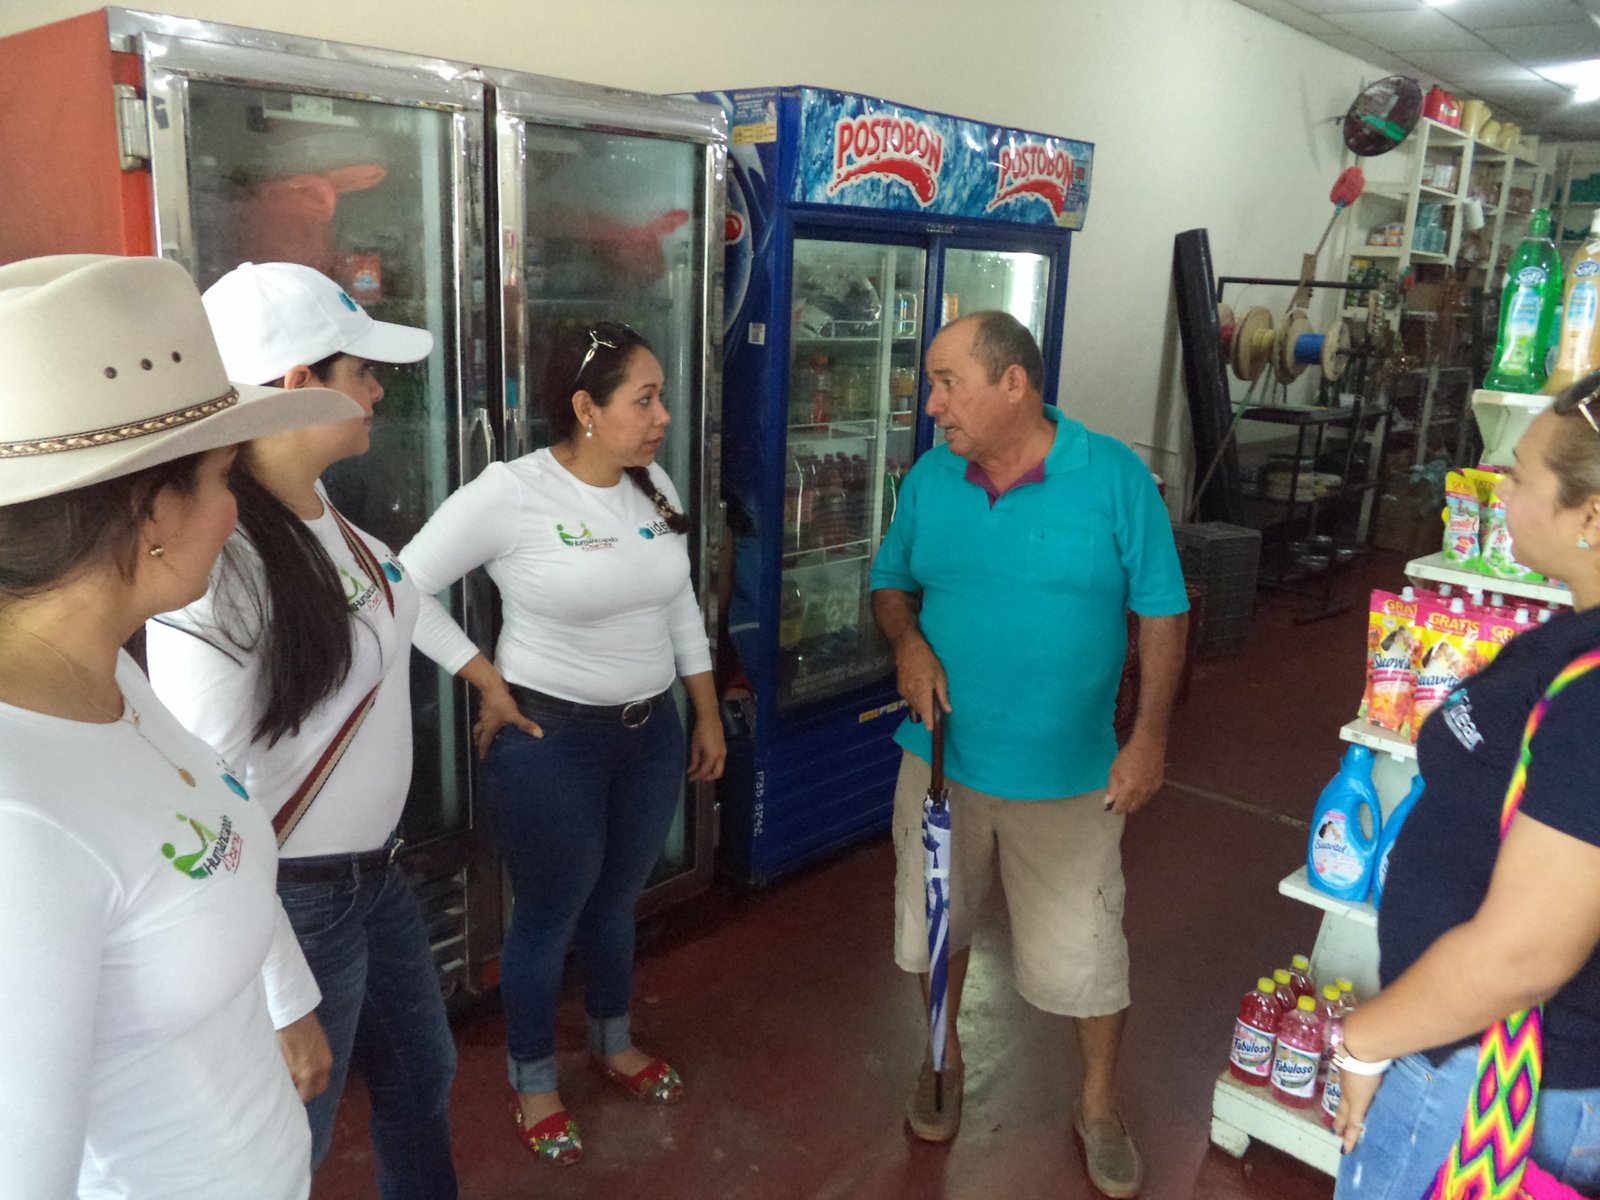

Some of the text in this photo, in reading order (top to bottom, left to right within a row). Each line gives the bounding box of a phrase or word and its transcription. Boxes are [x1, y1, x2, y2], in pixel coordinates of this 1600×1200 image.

[836, 117, 943, 175] POSTOBON
[999, 145, 1075, 190] POSTOBON
[1428, 612, 1479, 631] GRATIS
[1234, 1037, 1271, 1054] Fabuloso
[1276, 1059, 1313, 1075] Fabuloso
